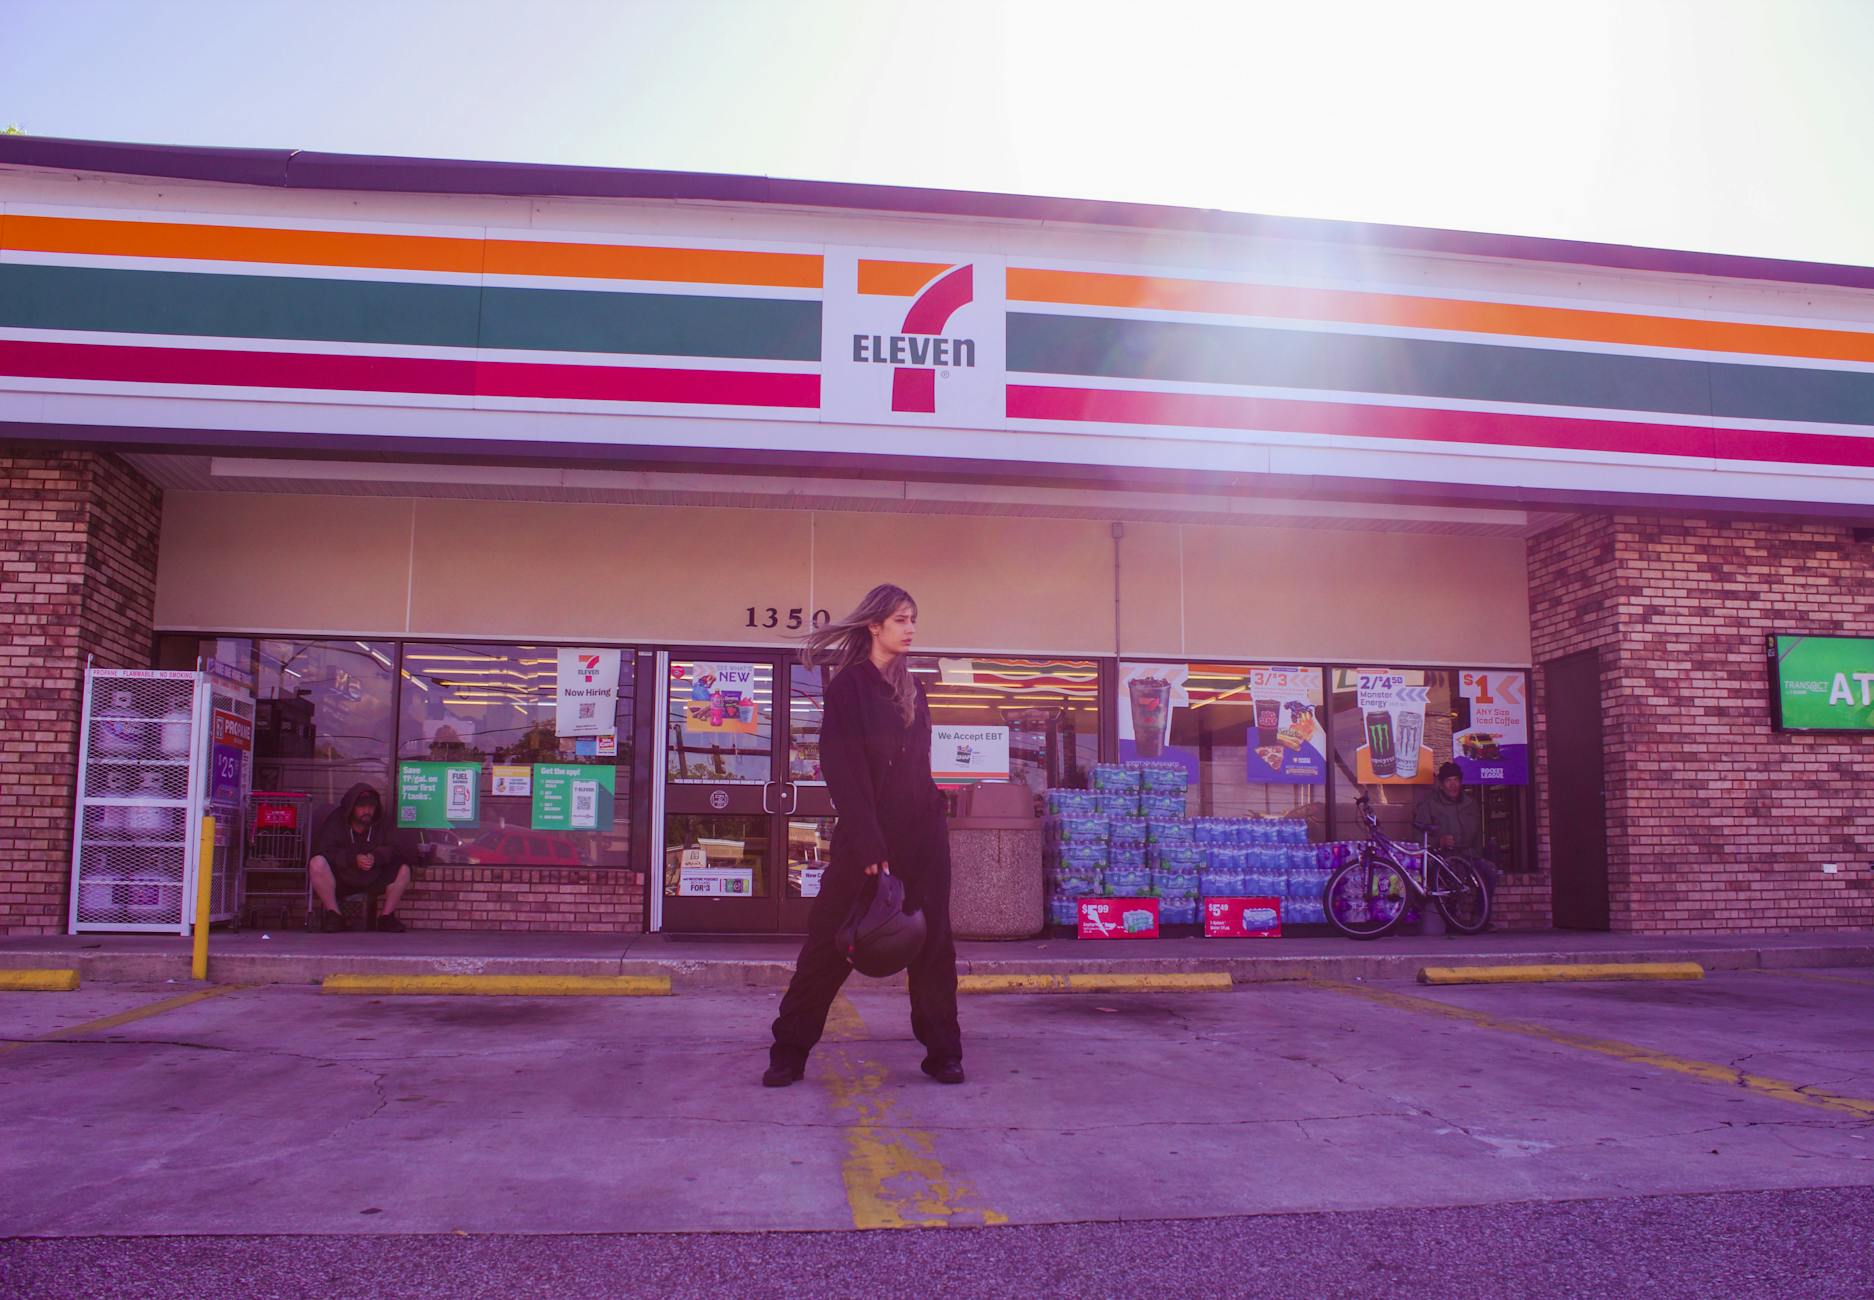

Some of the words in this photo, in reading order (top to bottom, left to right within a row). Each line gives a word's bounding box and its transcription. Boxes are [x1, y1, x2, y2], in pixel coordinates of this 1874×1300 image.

[858, 259, 973, 413] 7
[745, 607, 831, 629] 1350
[93, 669, 118, 677] PROPANE
[123, 670, 155, 678] FLAMMABLE
[719, 671, 750, 682] NEW
[564, 688, 585, 697] Now
[586, 687, 612, 698] Hiring
[1463, 674, 1494, 704] $1
[1360, 700, 1387, 708] Energy
[1476, 717, 1494, 725] Iced
[1495, 717, 1520, 727] Coffee
[224, 719, 251, 741] PROPANE
[937, 732, 952, 740] We
[953, 731, 984, 741] Accept
[402, 766, 421, 774] Save
[540, 767, 553, 775] Get
[554, 767, 566, 775] the
[402, 785, 420, 793] your
[420, 783, 436, 792] first
[690, 884, 704, 892] FOR
